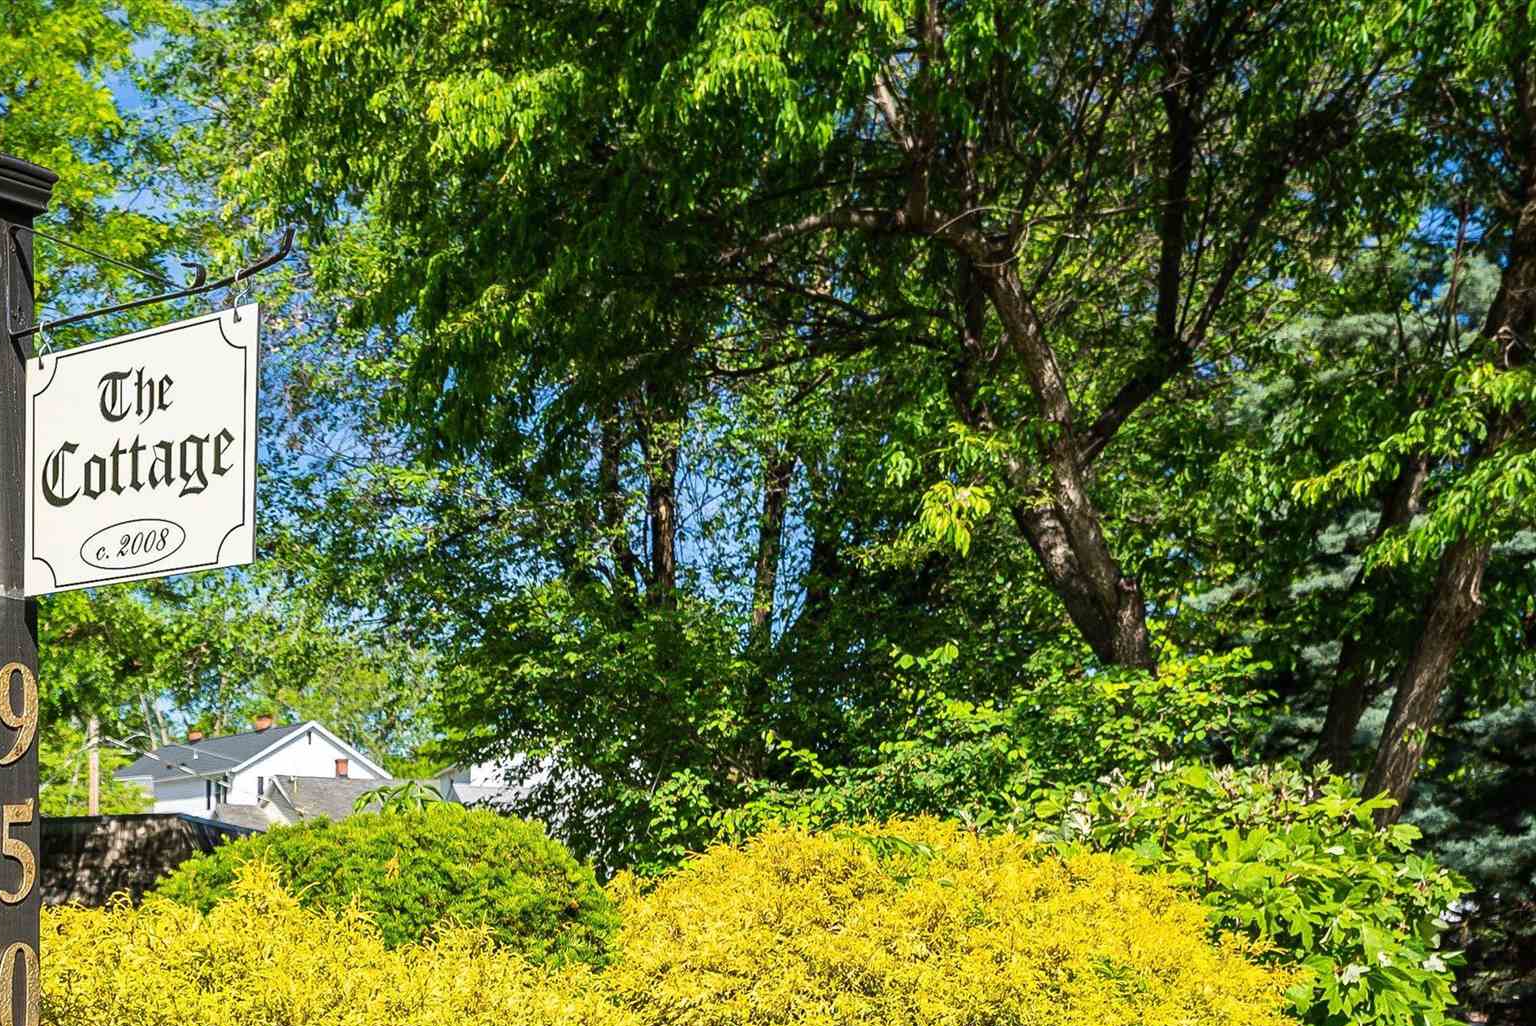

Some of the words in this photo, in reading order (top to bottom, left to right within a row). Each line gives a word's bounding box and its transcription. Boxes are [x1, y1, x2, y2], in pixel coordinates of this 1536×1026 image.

[97, 366, 174, 424] The
[41, 427, 235, 508] Cottage
[95, 545, 110, 561] c.
[116, 528, 170, 558] 2008
